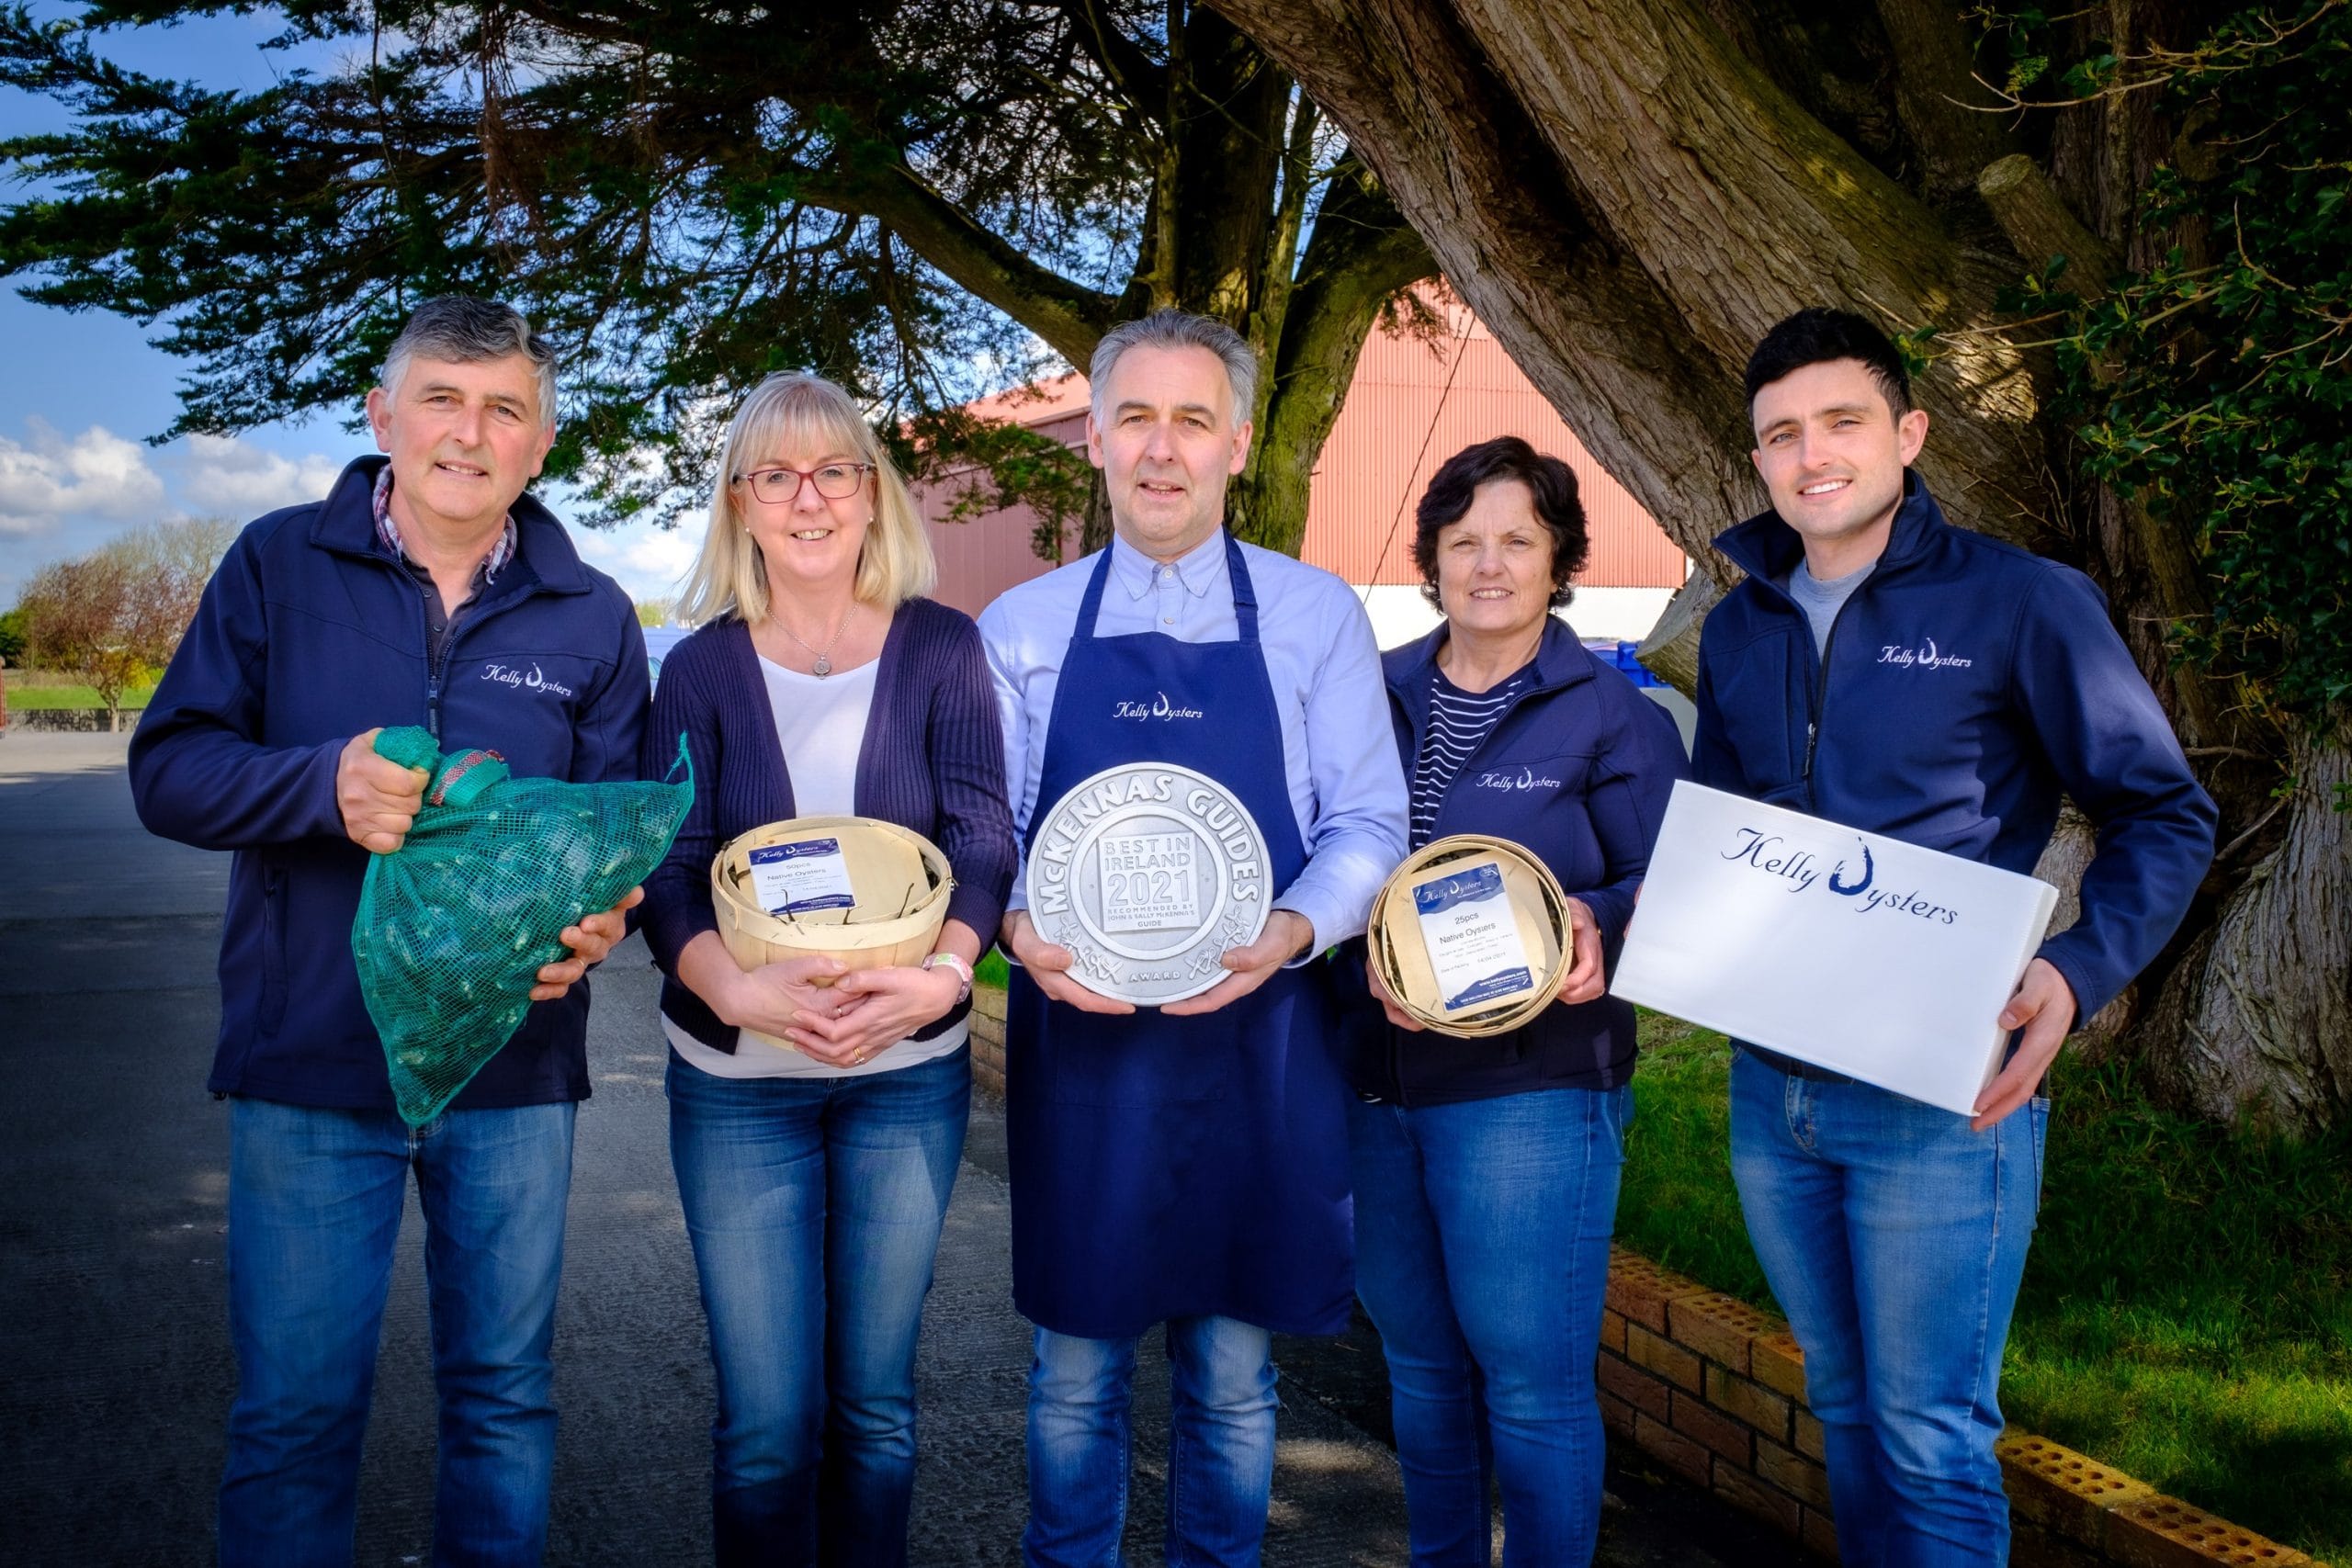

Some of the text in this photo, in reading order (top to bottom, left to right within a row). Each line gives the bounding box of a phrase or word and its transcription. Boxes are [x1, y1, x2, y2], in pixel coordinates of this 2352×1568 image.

[1877, 646, 1916, 669] Kelly
[481, 664, 523, 688] Kelly
[1113, 702, 1150, 722] Kelly
[1476, 773, 1514, 793] Kelly
[1103, 837, 1191, 855] BEST IN
[1186, 788, 1260, 903] GUIDES
[1104, 852, 1191, 872] IRELAND
[1720, 828, 1821, 893] Kelly
[1107, 869, 1191, 907] 2021
[1420, 890, 1448, 903] Kelly
[1107, 905, 1179, 915] RECOMMENDED
[1454, 911, 1480, 927] 25pcs
[1137, 919, 1162, 928] GUIDE
[1439, 932, 1464, 945] Native
[1465, 922, 1497, 938] Oysters
[1128, 972, 1182, 984] AWARD
